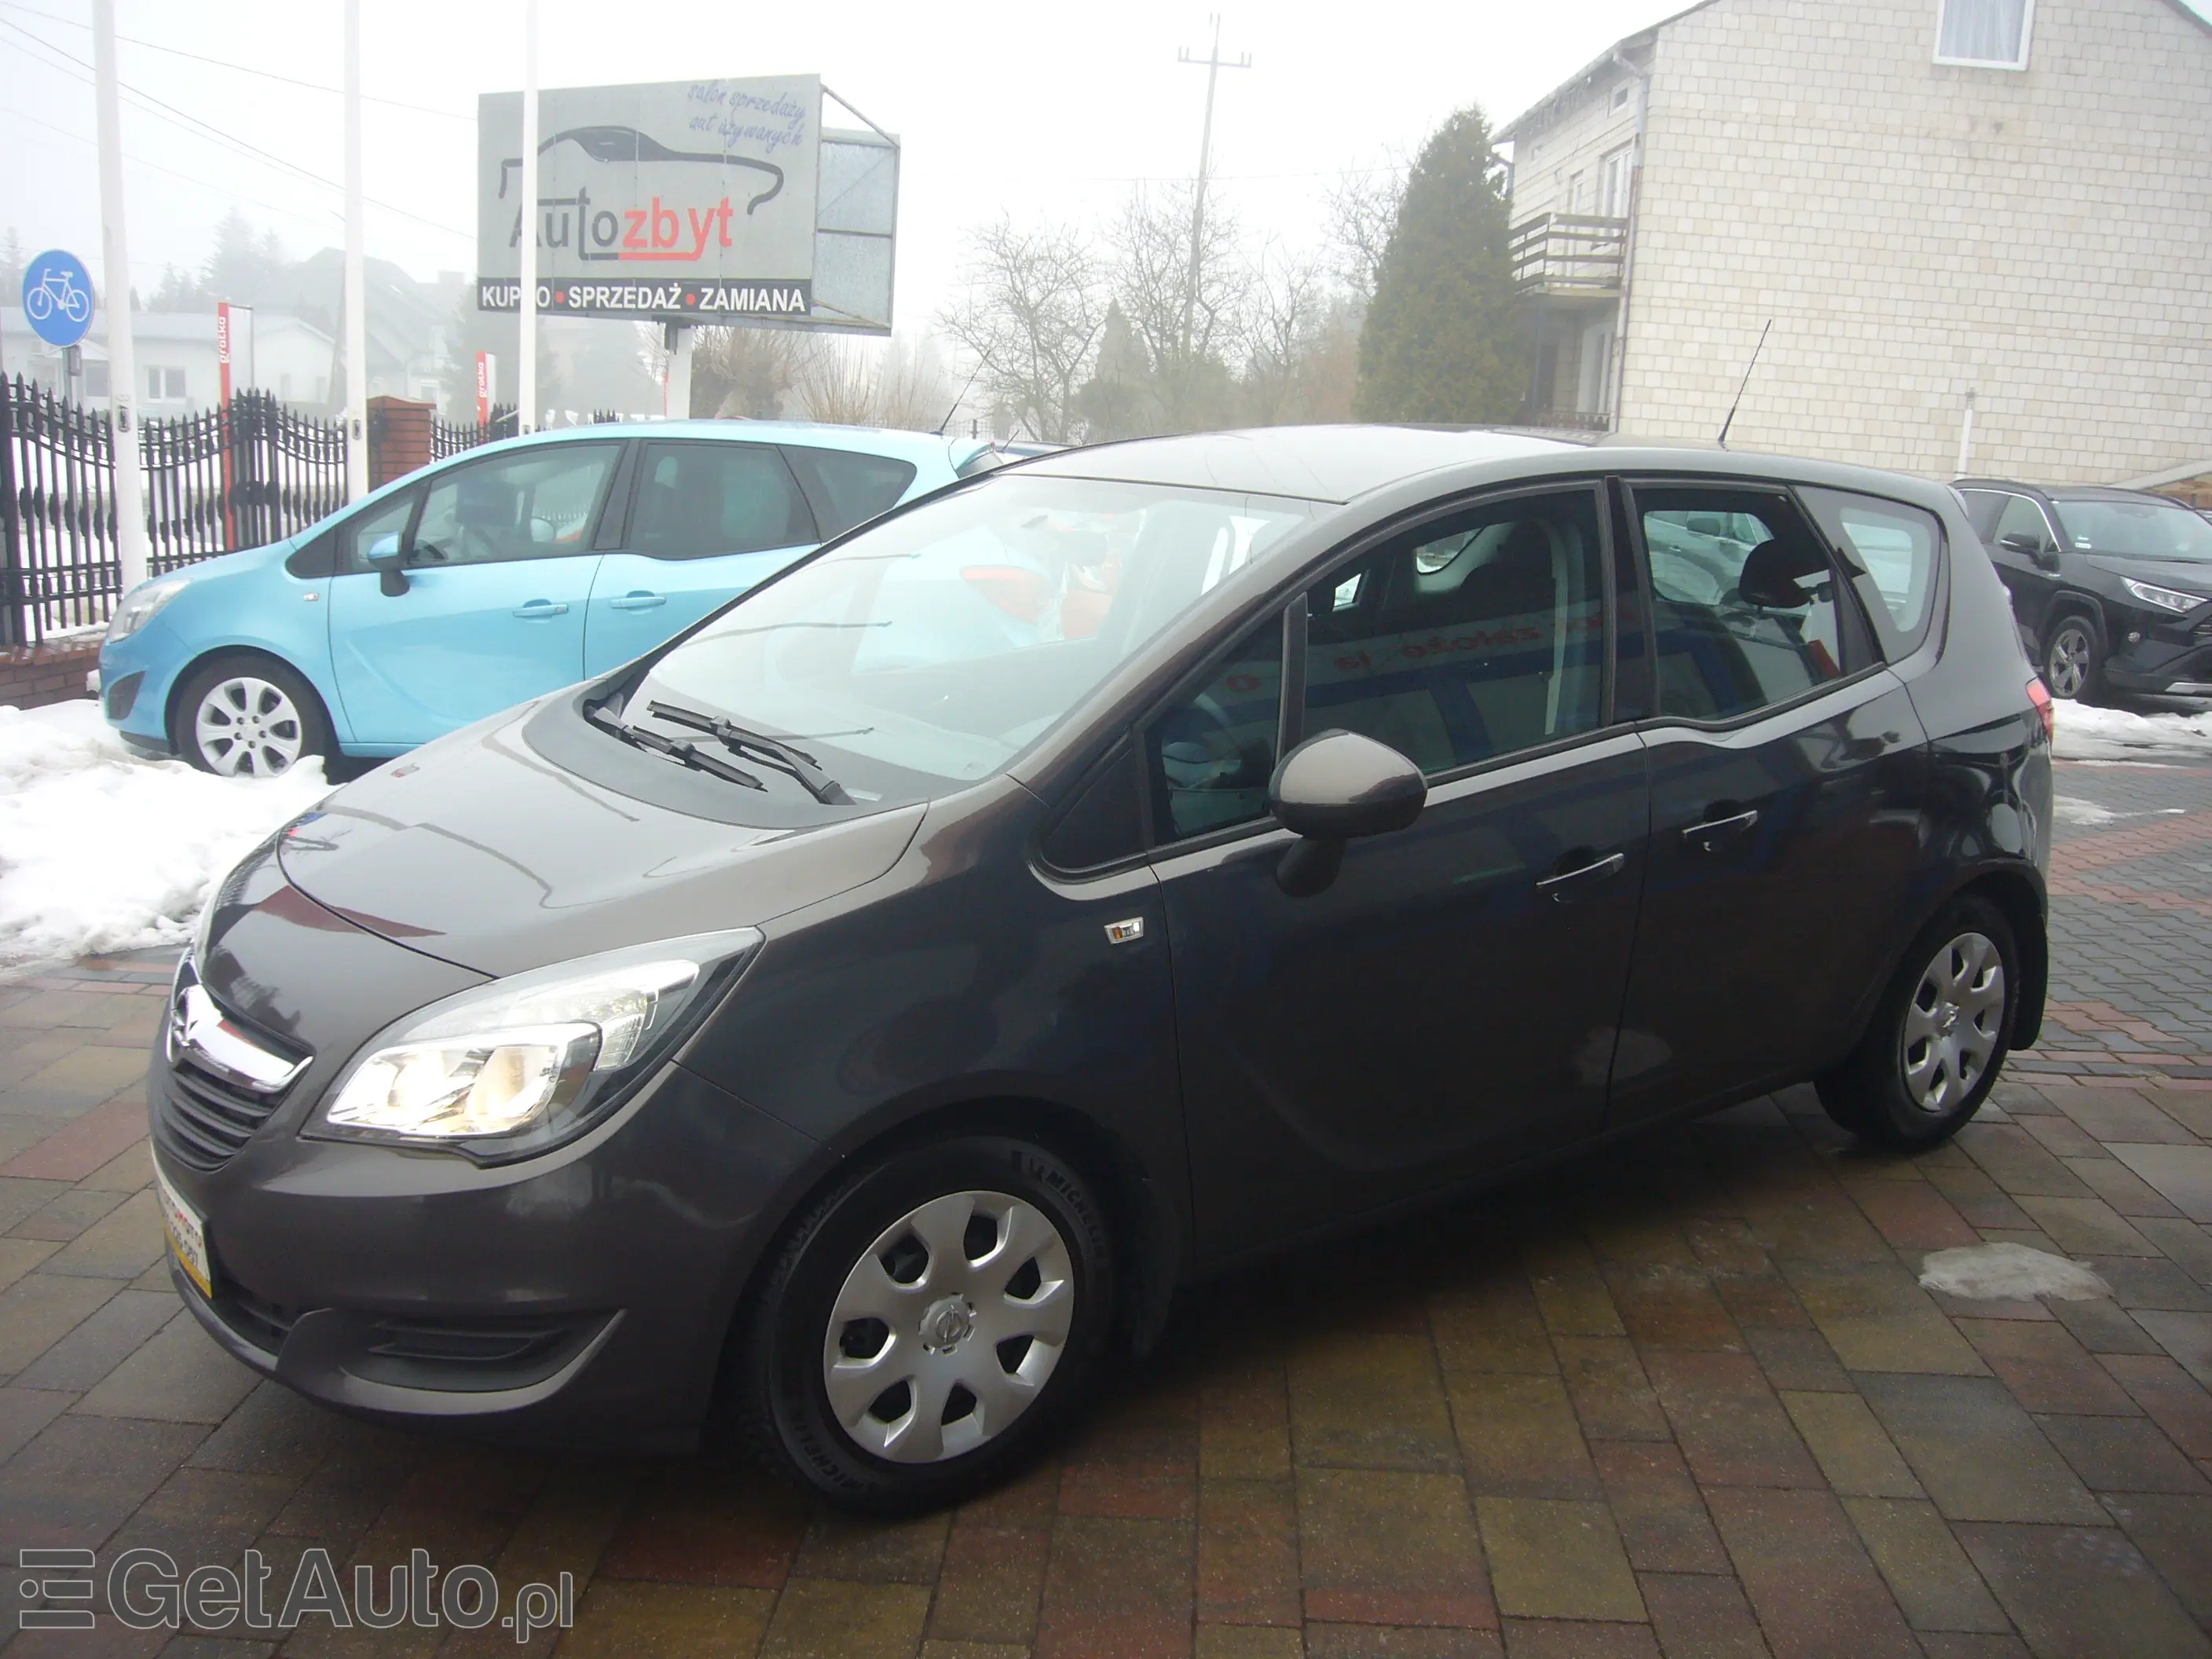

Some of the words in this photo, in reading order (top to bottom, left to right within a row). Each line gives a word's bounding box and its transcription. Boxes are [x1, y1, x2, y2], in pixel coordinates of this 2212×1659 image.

[729, 92, 806, 130] sprzedaży
[482, 286, 551, 308] KUPO
[568, 283, 682, 309] SPRZEDAŻ
[699, 287, 806, 313] ZAMIANA
